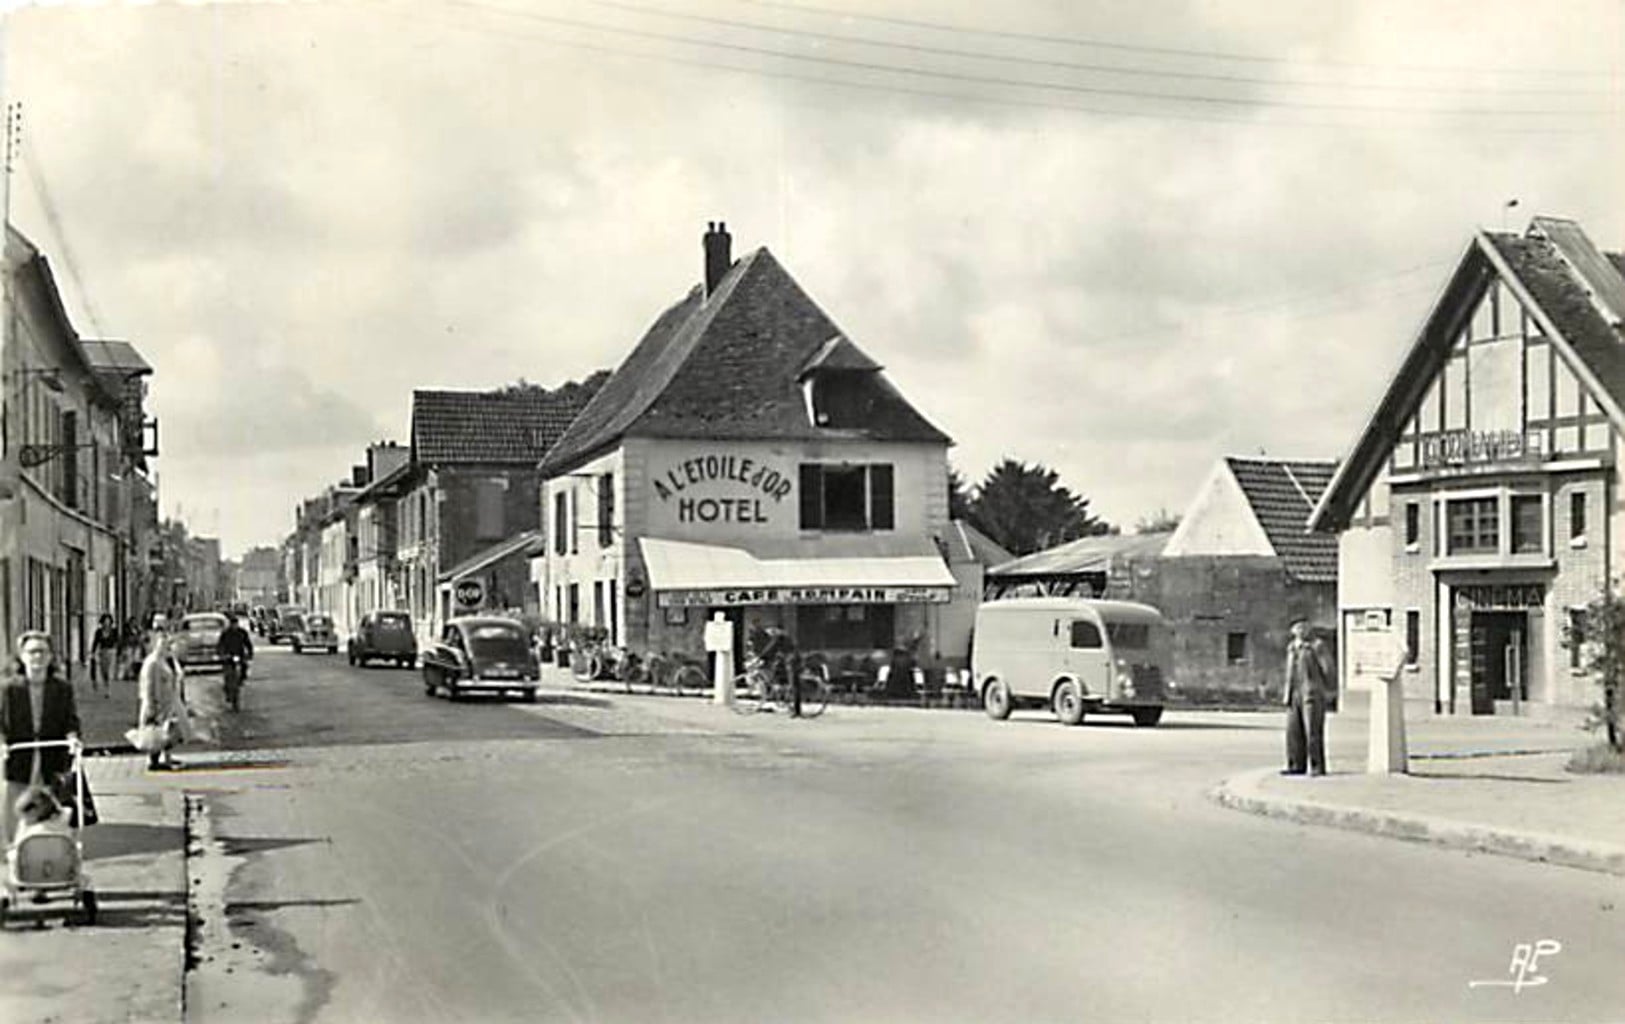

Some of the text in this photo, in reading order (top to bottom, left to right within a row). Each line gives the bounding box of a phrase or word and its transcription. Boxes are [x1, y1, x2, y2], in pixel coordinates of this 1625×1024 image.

[654, 479, 673, 501] A
[667, 455, 753, 491] L'ETOILE
[679, 498, 768, 522] HOTEL
